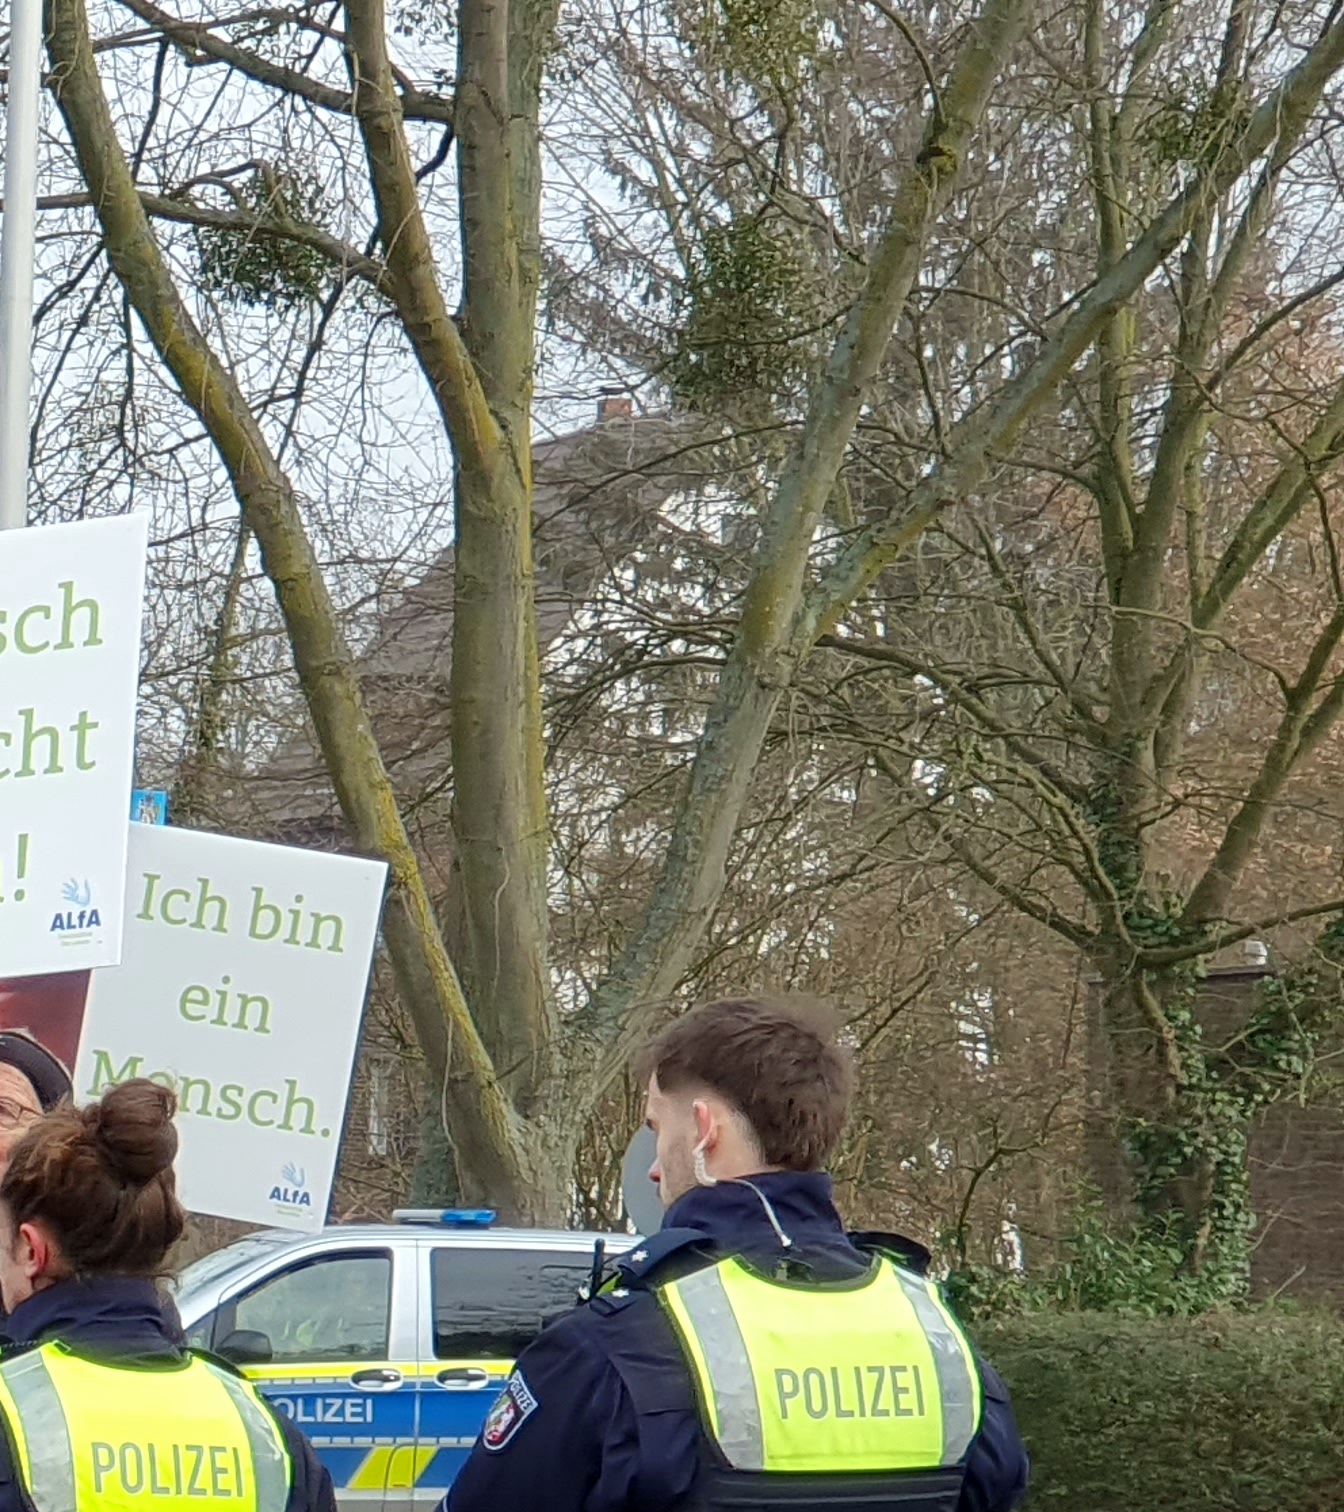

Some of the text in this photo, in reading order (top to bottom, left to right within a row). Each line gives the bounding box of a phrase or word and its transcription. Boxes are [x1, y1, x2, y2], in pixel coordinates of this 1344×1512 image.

[49, 908, 102, 932] ALfA
[136, 873, 347, 954] Ich bin
[178, 975, 272, 1035] ein
[87, 1048, 334, 1139] Mnsch.
[269, 1186, 311, 1206] ALfA
[273, 1397, 374, 1423] OLIZEI
[774, 1364, 927, 1420] POLIZEI
[91, 1441, 245, 1499] POLIZEI
